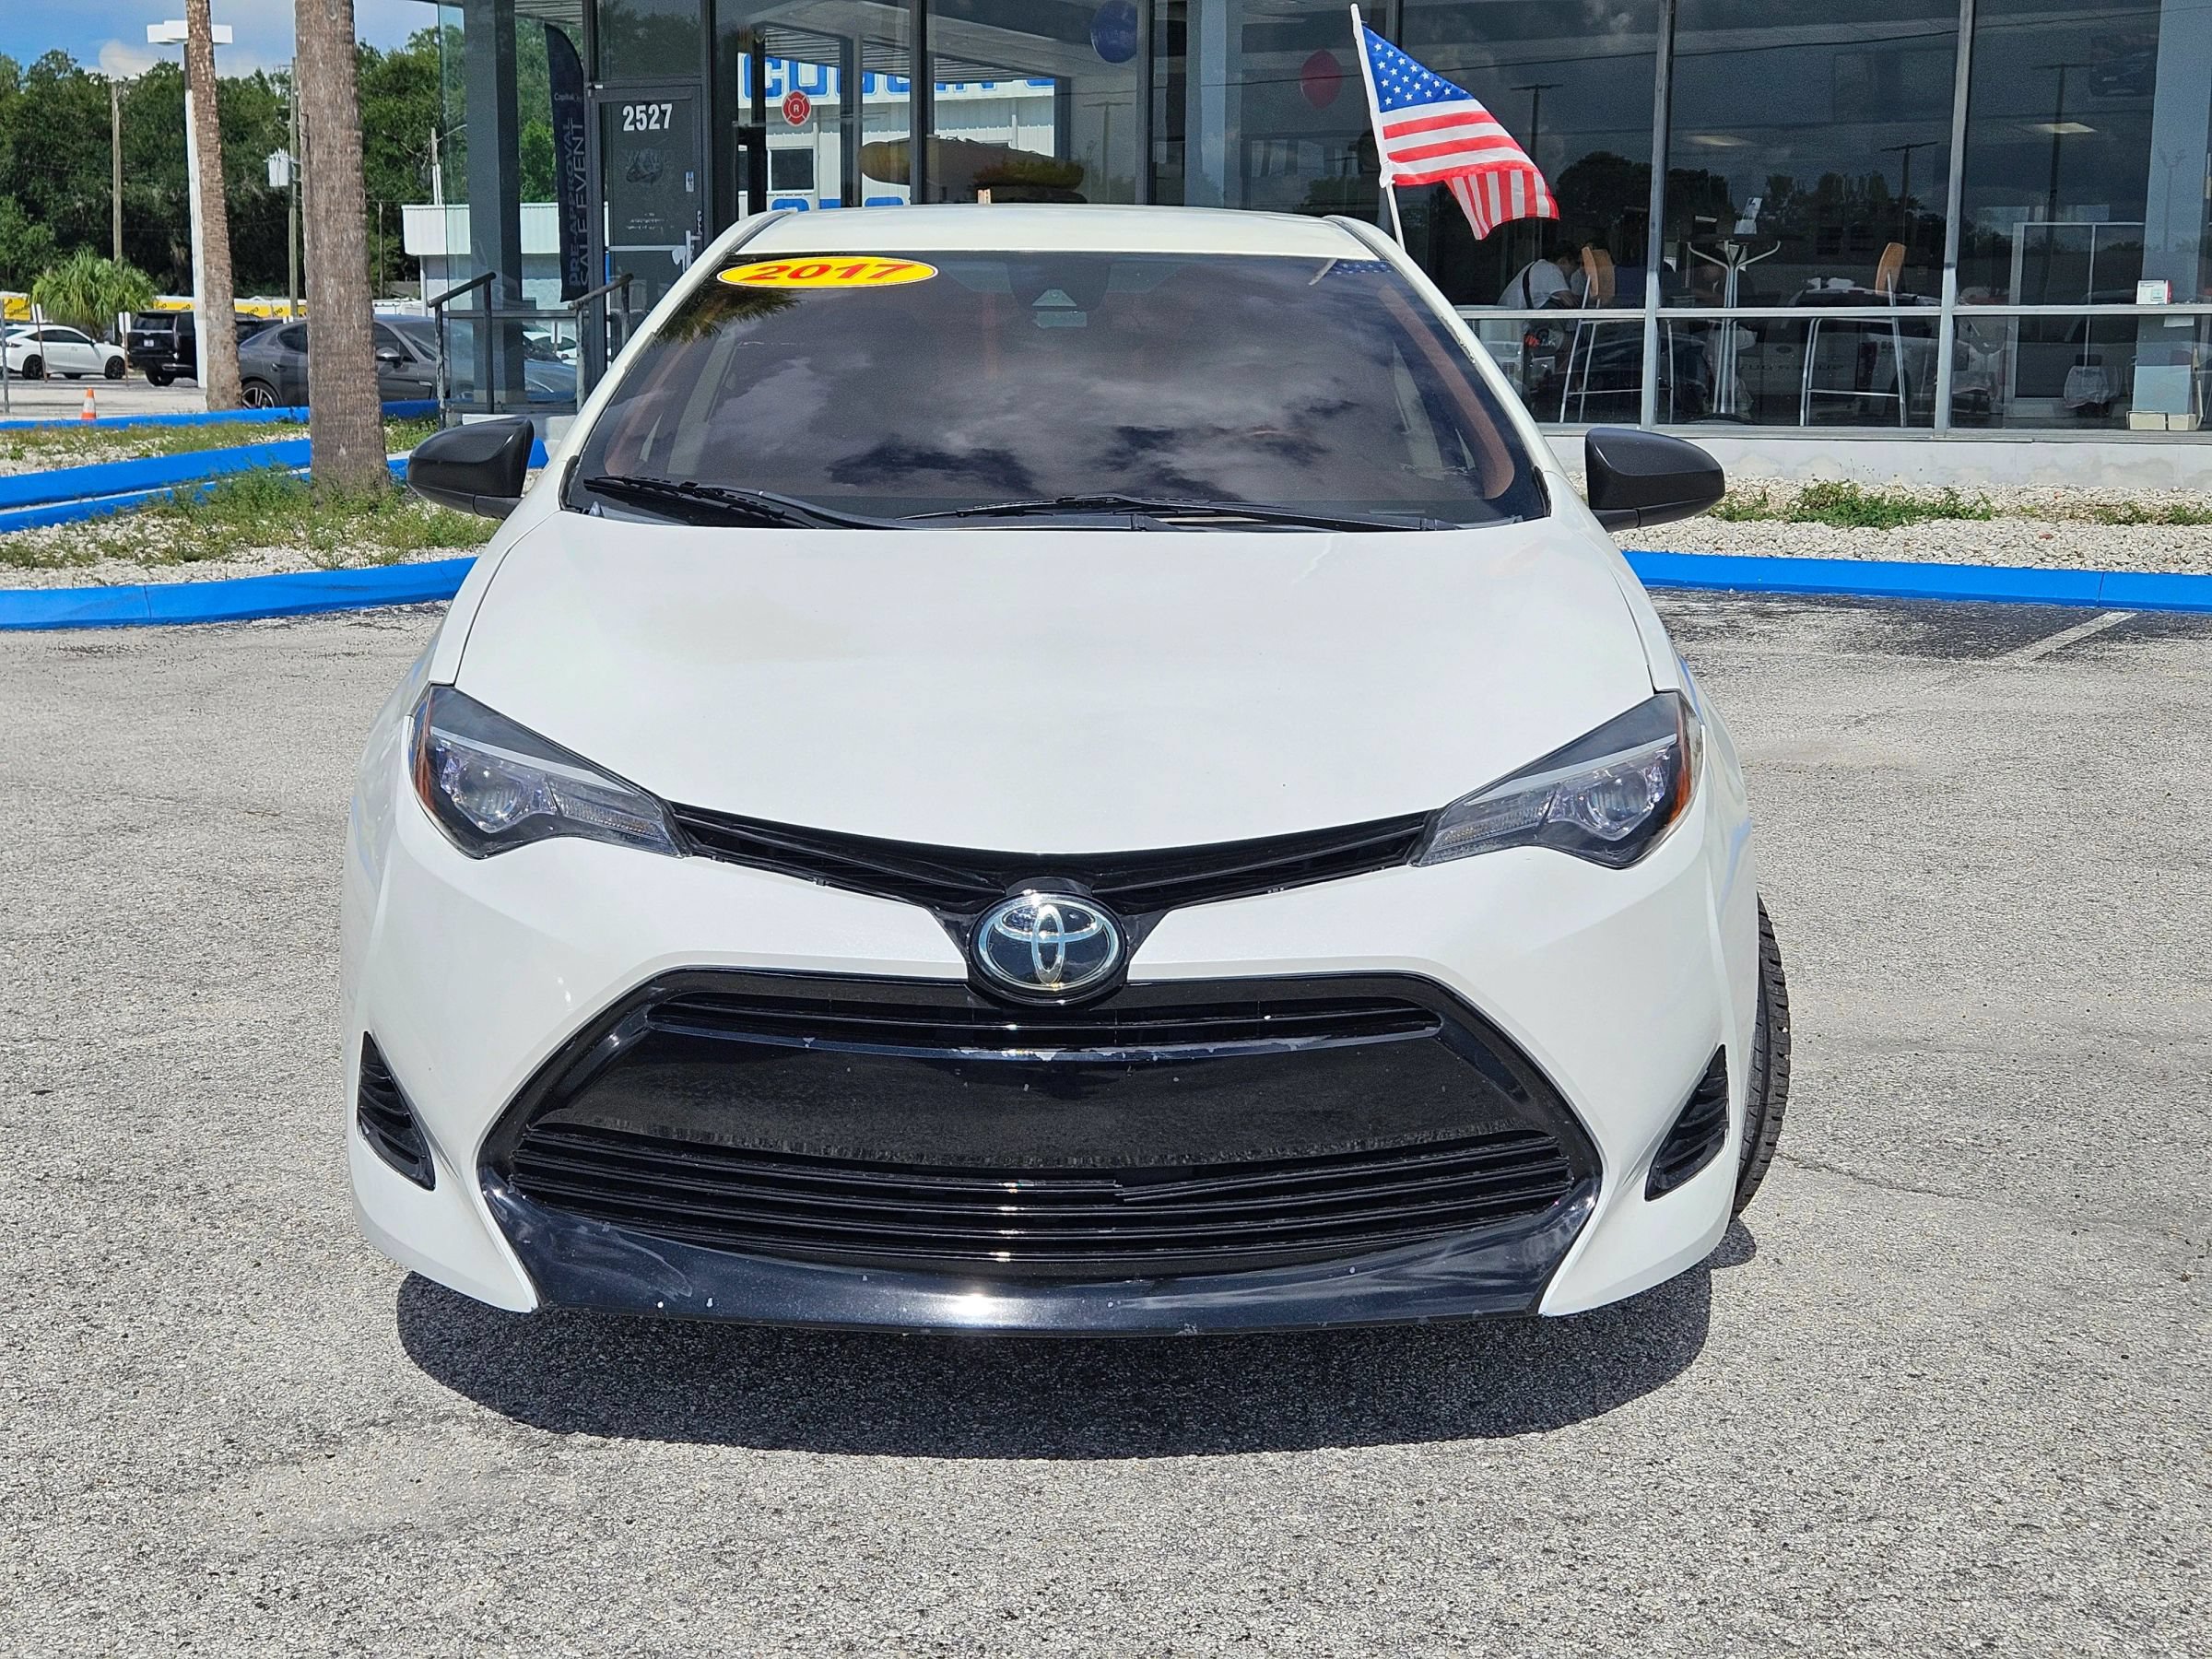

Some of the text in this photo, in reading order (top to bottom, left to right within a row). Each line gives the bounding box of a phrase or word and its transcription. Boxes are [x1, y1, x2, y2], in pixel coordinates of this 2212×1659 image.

[622, 103, 673, 131] 2527
[793, 103, 800, 112] R
[562, 117, 581, 286] PRE-APPROVAL
[740, 264, 913, 280] 2017
